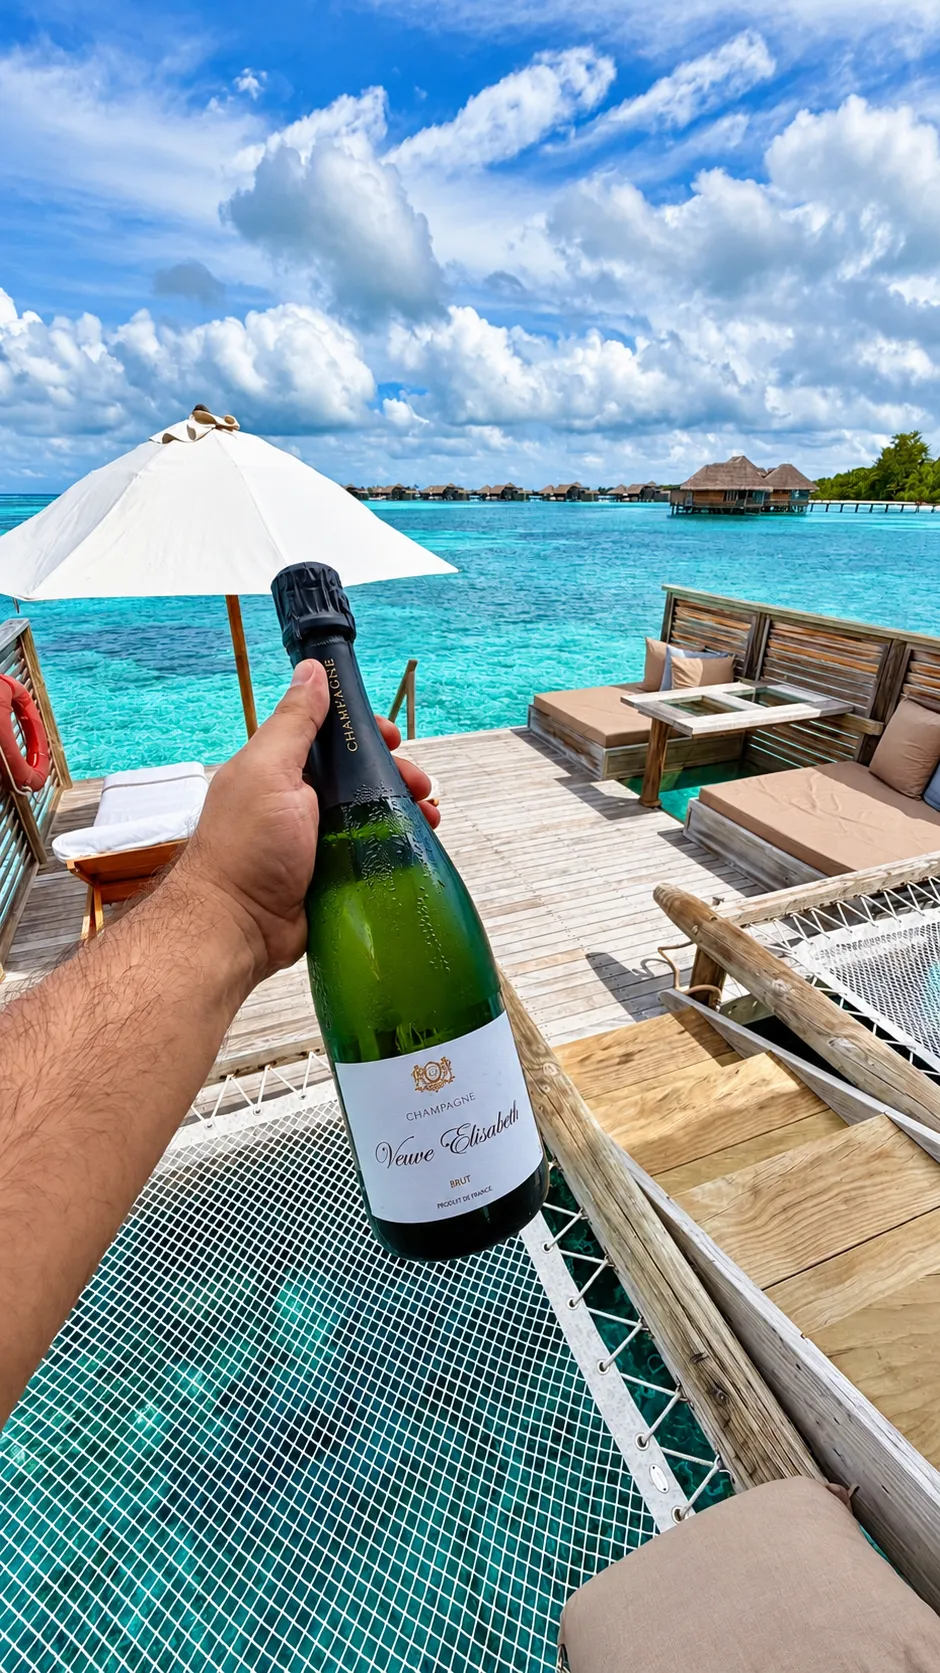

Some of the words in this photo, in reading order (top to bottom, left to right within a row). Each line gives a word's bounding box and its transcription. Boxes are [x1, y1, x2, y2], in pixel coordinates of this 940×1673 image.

[324, 658, 359, 752] CHAMPAGNE
[405, 1092, 476, 1121] CHAMPAGNE
[375, 1135, 435, 1169] Veuve
[440, 1100, 519, 1154] Elisabeth
[449, 1174, 471, 1188] BRUT
